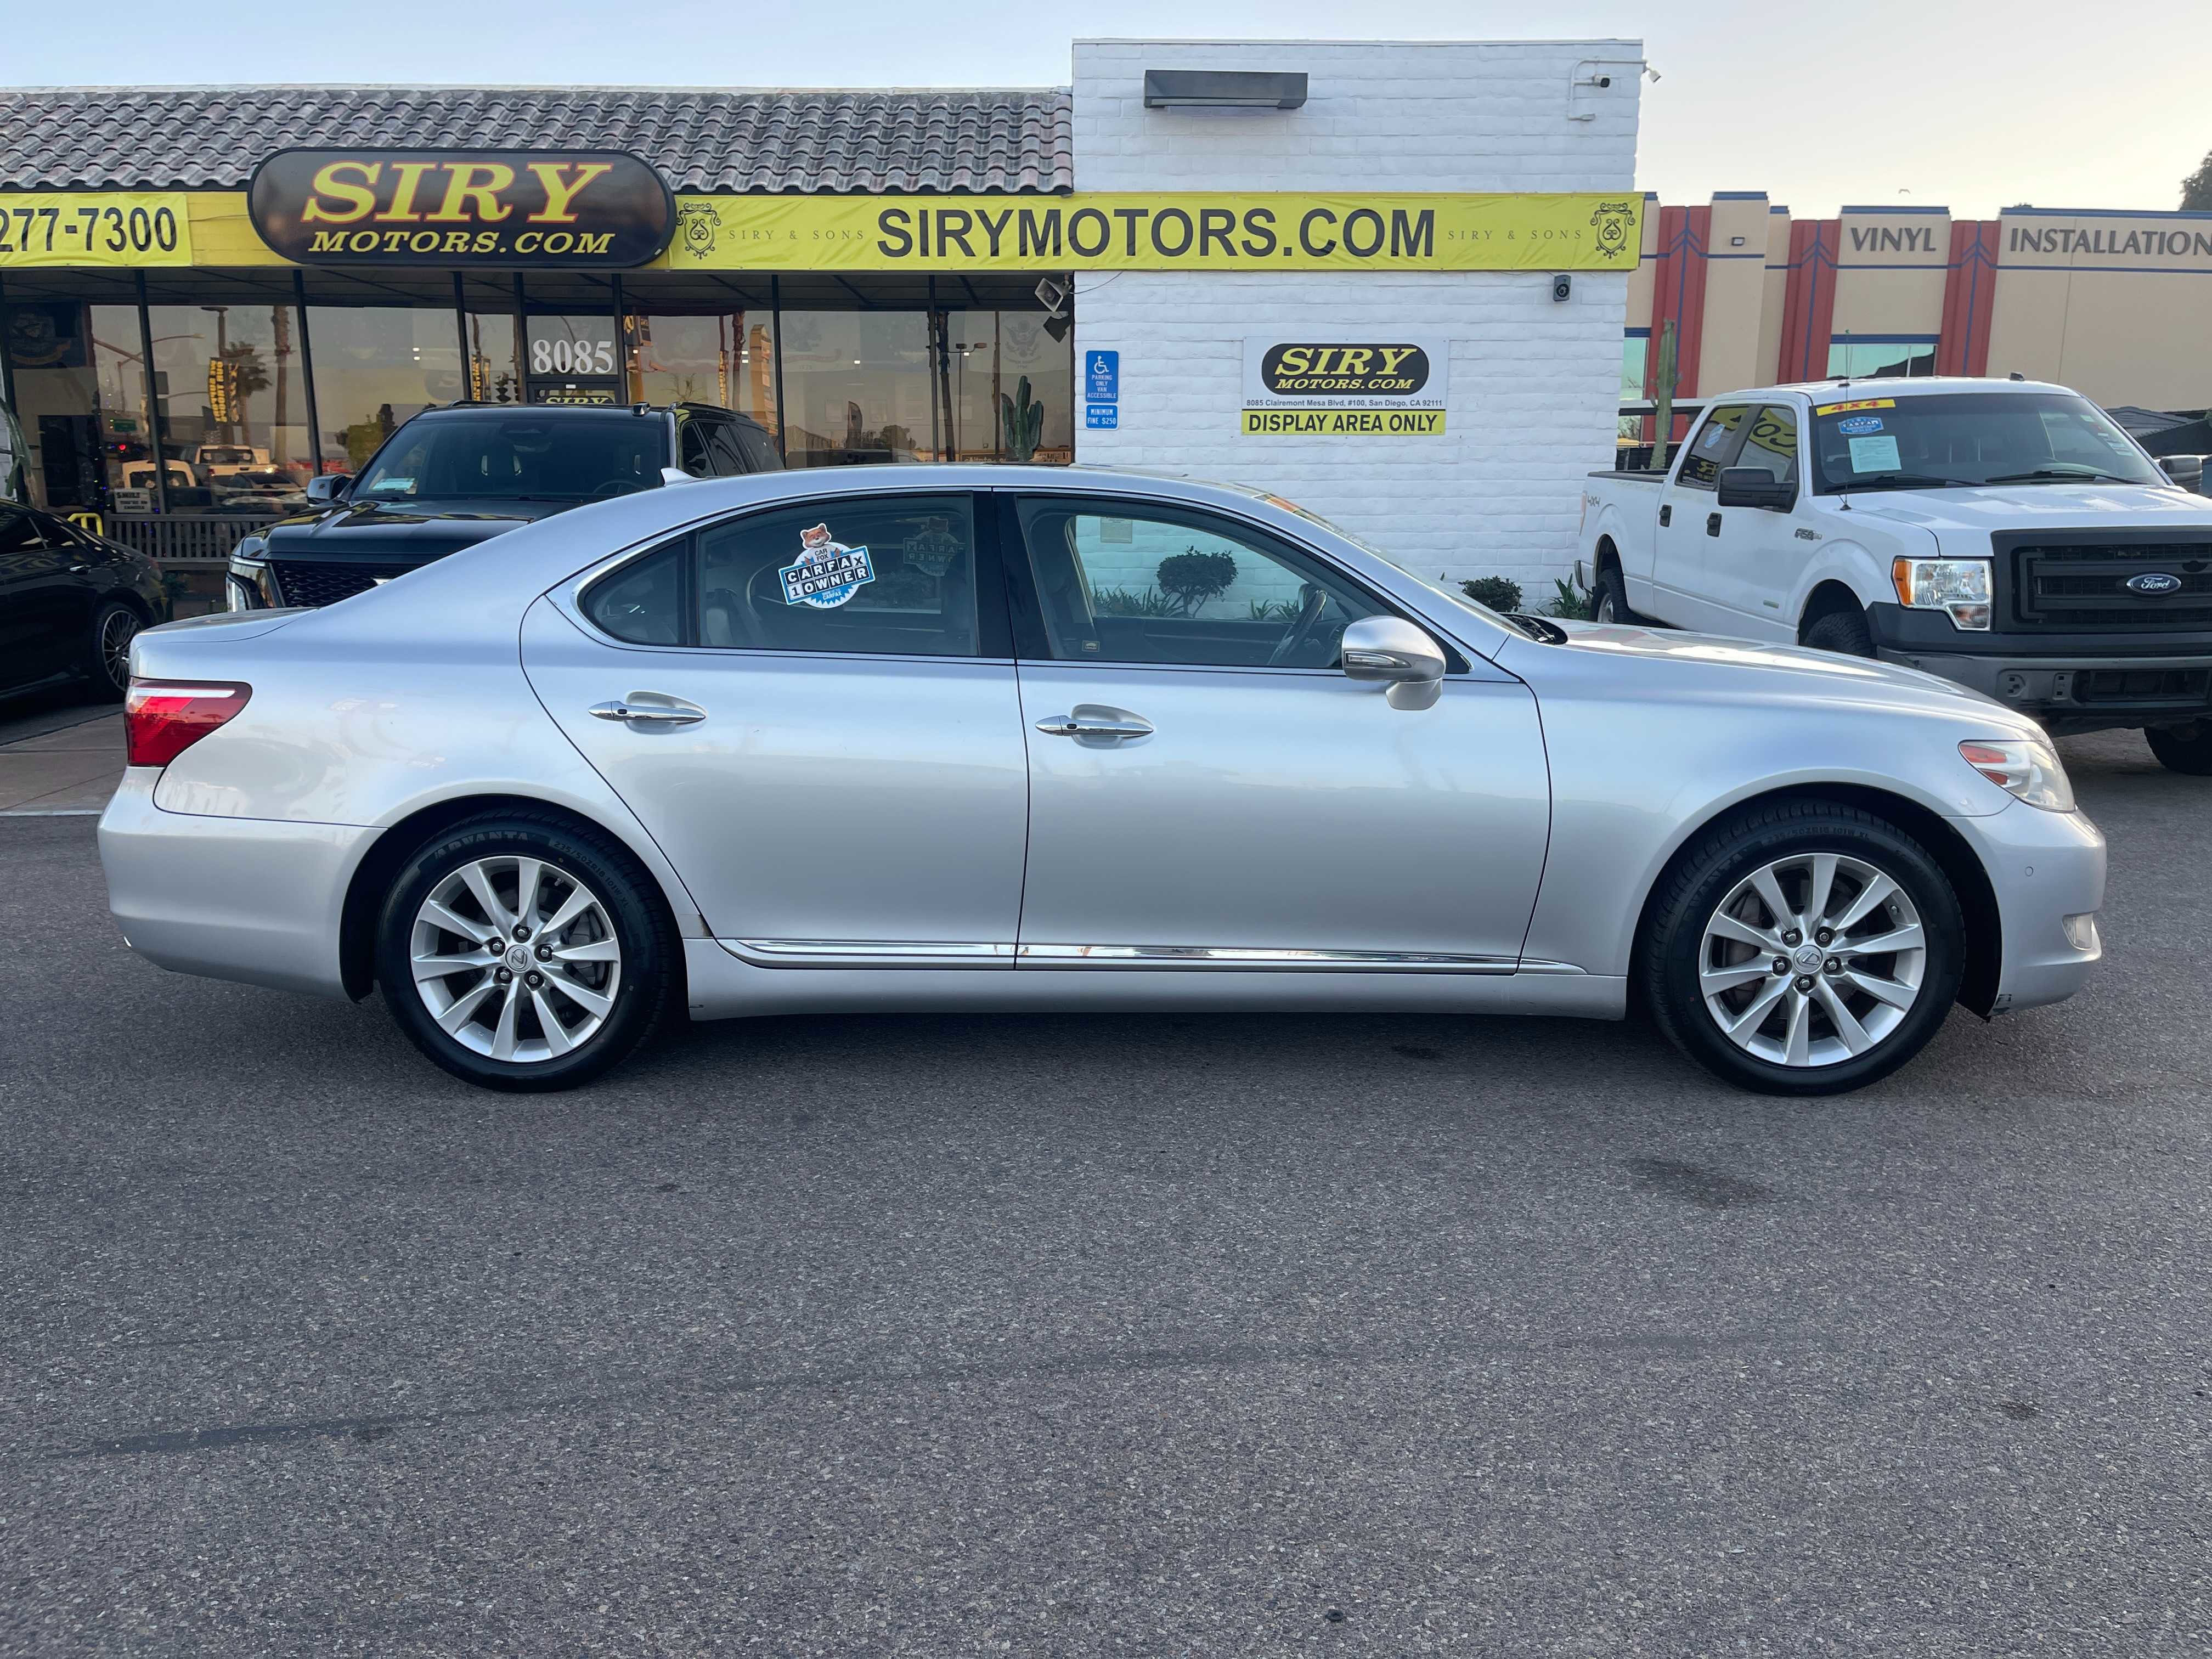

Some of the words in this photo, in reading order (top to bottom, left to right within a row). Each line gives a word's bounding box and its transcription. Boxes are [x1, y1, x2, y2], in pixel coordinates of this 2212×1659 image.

[301, 160, 613, 223] SIRY
[0, 207, 177, 252] 277-7300
[308, 230, 614, 254] MOTORS.COM
[729, 230, 774, 240] SIRY
[789, 230, 798, 240] &
[813, 230, 865, 240] SONS
[878, 208, 1435, 258] SIRYMOTORS.COM
[1448, 230, 1493, 240] SIRY
[1507, 230, 1515, 240] &
[1531, 230, 1582, 240] SONS
[1850, 227, 1936, 252] VINYL
[2010, 228, 2212, 256] INSTALLATION
[533, 340, 613, 373] 8085
[1274, 347, 1417, 375] SIRY
[1275, 379, 1415, 390] MOTORS.COM
[1249, 414, 1328, 431] DISPLAY
[1332, 414, 1383, 431] AREA
[1389, 414, 1438, 431] ONLY
[787, 556, 864, 583] CARFAX
[792, 586, 800, 596] 1
[804, 568, 867, 593] OWNER
[823, 591, 842, 600] CARFAX
[2141, 577, 2170, 589] Ford
